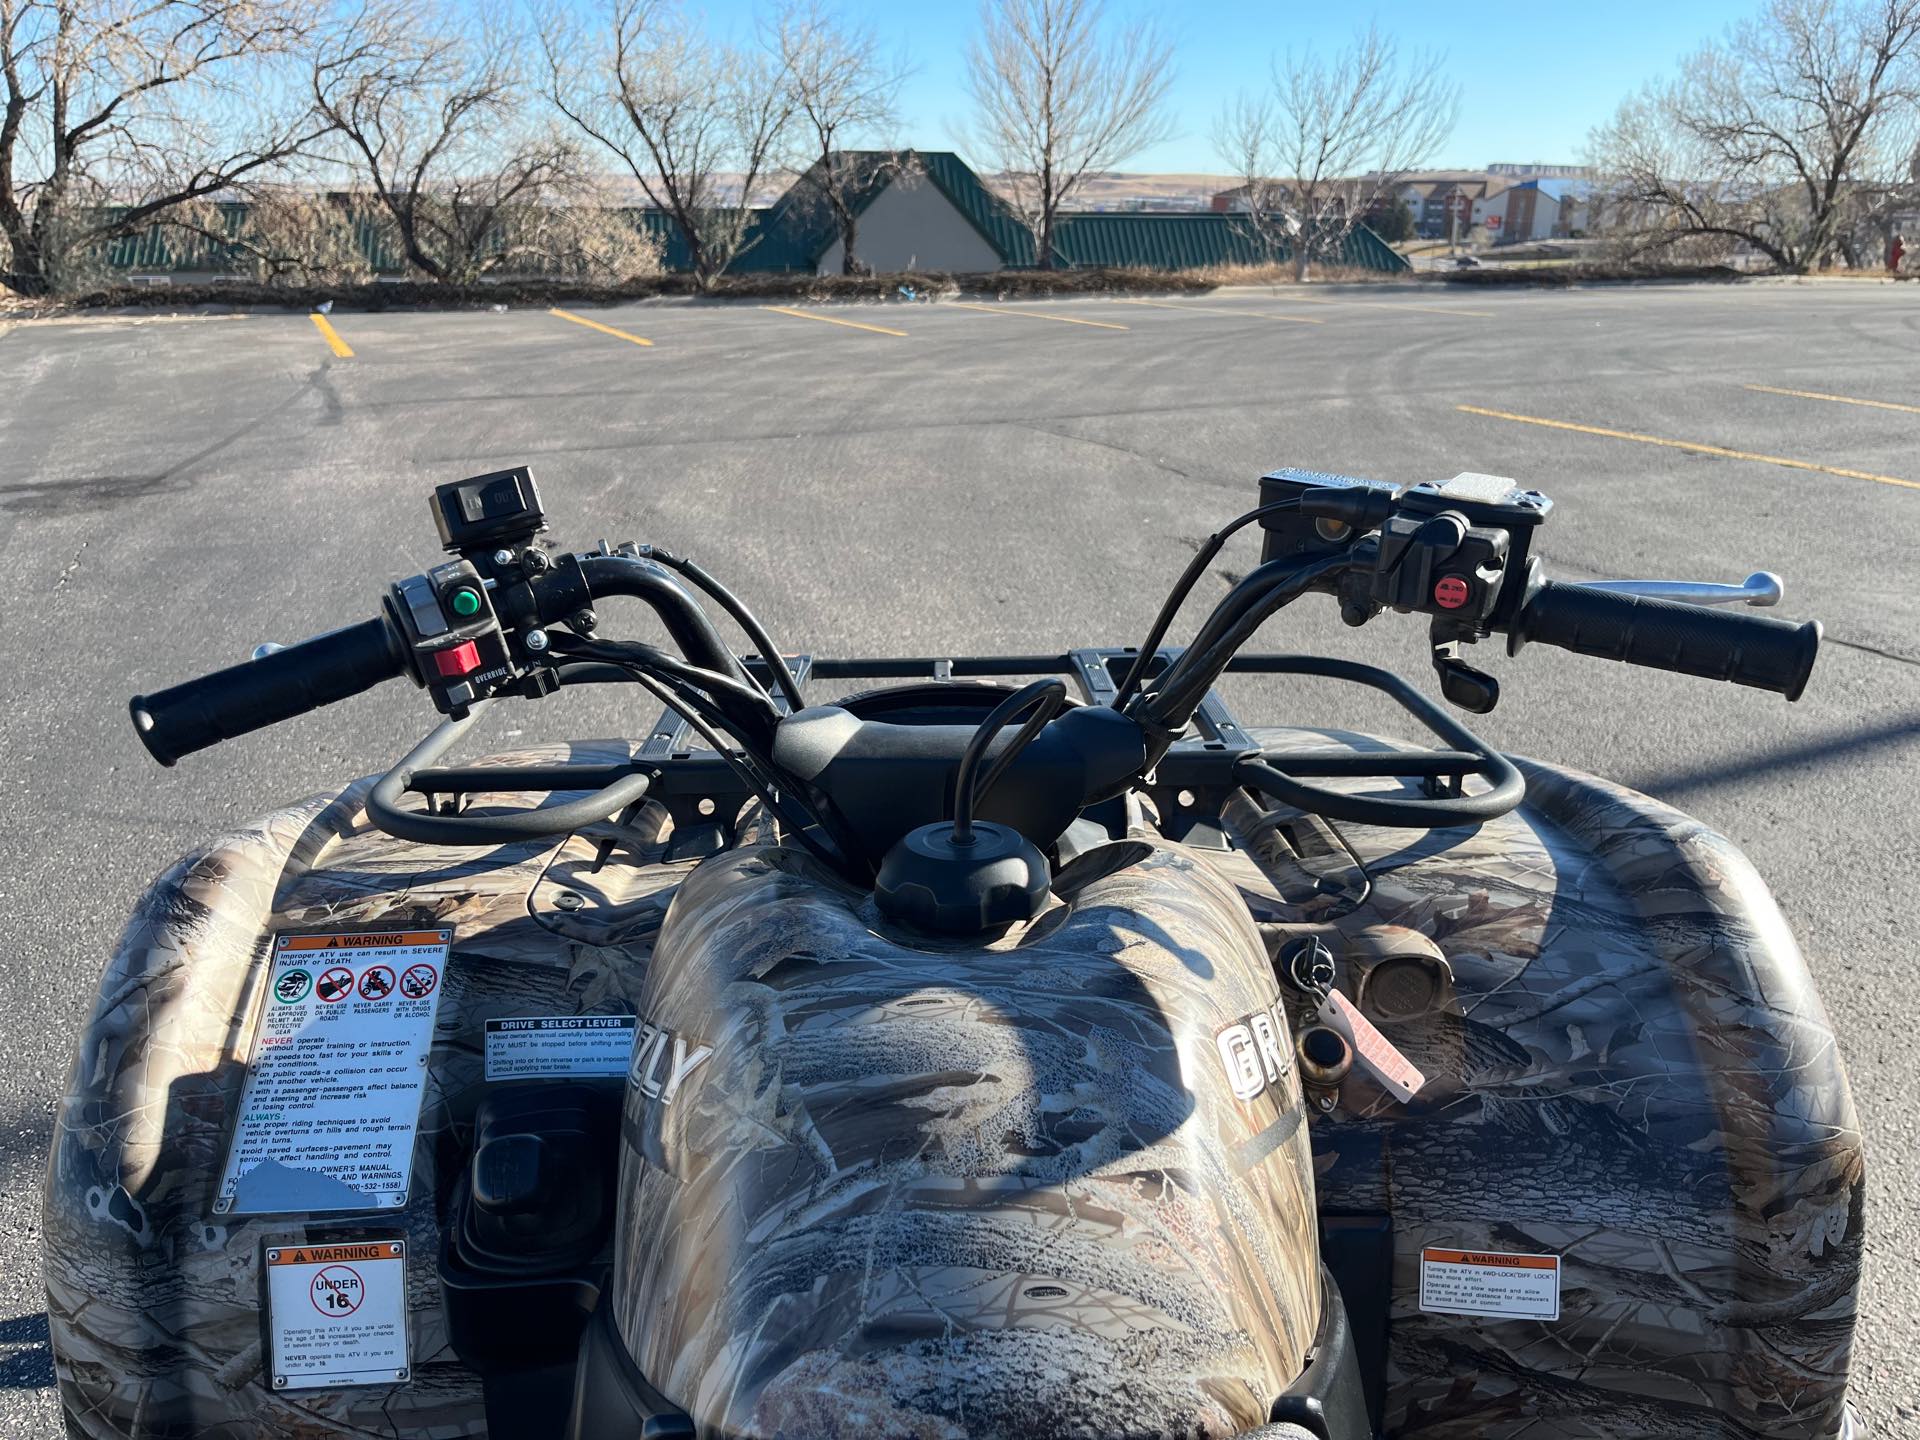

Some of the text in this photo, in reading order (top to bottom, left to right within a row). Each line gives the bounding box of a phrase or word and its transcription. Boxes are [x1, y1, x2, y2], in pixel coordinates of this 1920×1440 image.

[474, 667, 508, 684] OVERRIDE
[344, 935, 403, 947] WARNING
[281, 953, 315, 961] Improper
[501, 1019, 621, 1029] DRIVE SELECT LEVER
[262, 1037, 292, 1046] NEVER
[298, 1043, 323, 1051] proper
[273, 1070, 296, 1078] public
[282, 1086, 363, 1095] passenger-passengers
[363, 1125, 384, 1133] rough
[267, 1147, 291, 1155] paved
[296, 1144, 371, 1152] surfaces-pavement
[306, 1153, 339, 1161] handling
[319, 1165, 355, 1174] OWNER'S
[341, 1174, 357, 1182] AND
[311, 1246, 379, 1260] WARNING
[1472, 1255, 1519, 1265] WARNING
[316, 1279, 358, 1291] UNDER
[326, 1294, 350, 1308] 16
